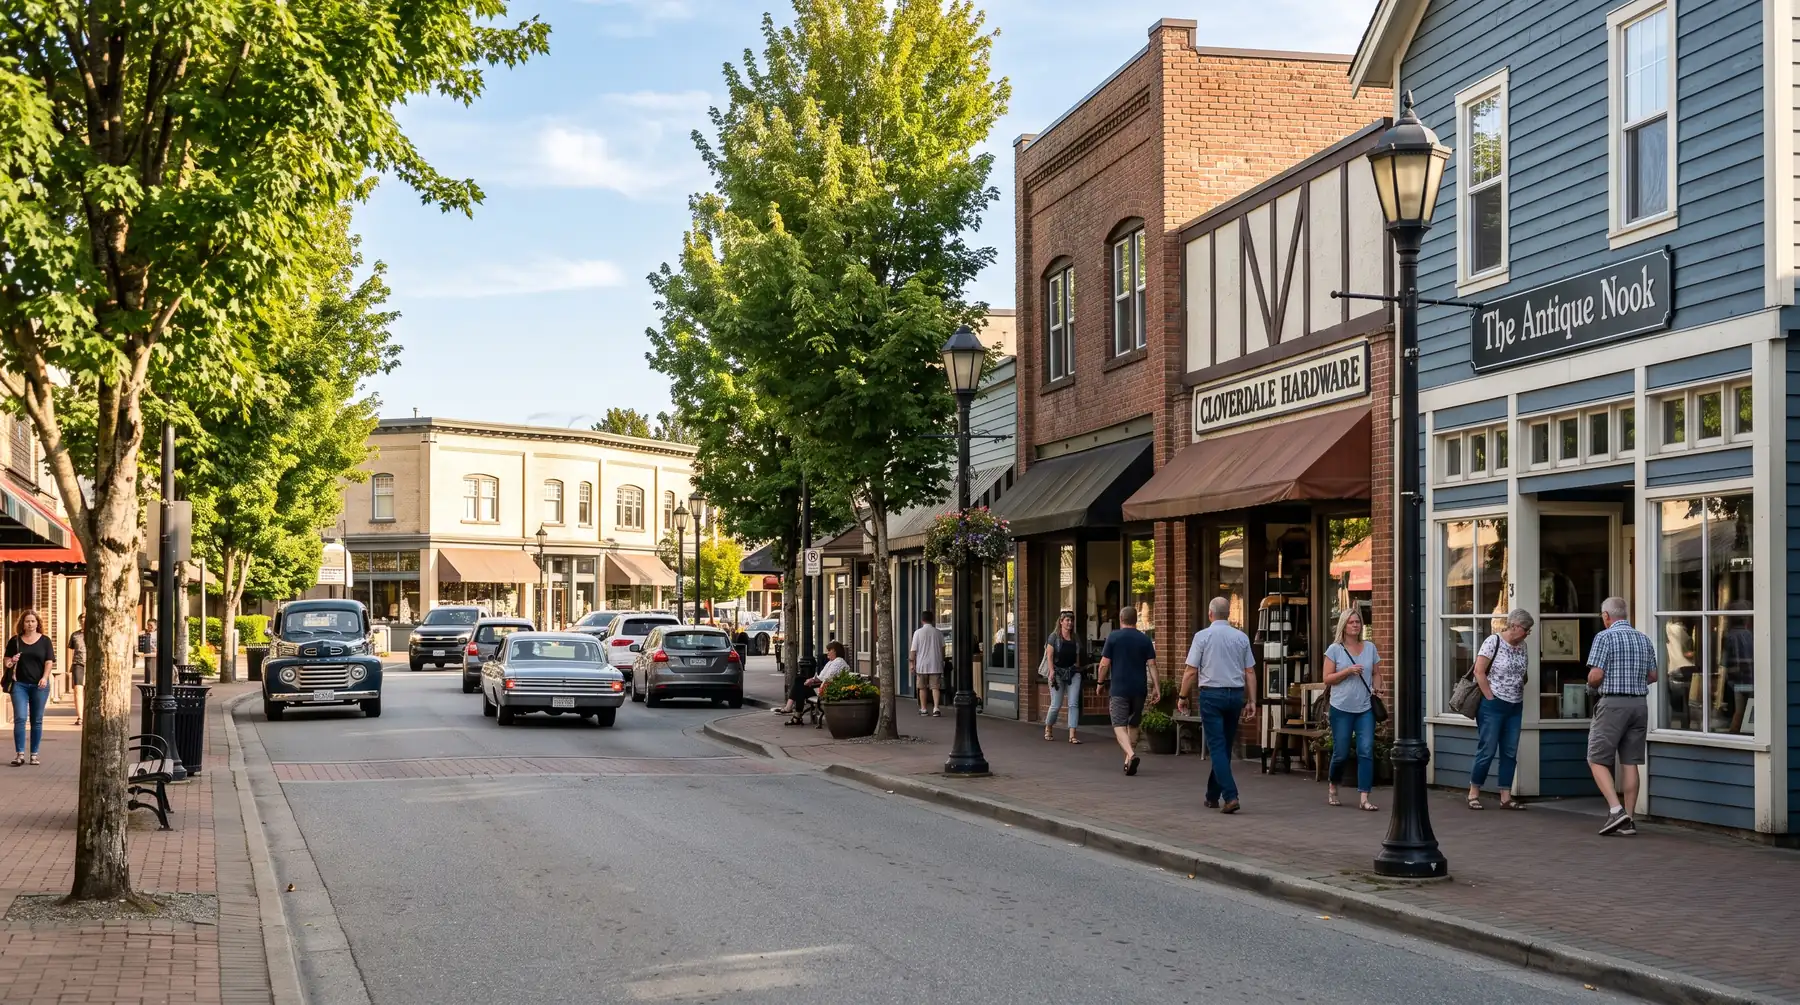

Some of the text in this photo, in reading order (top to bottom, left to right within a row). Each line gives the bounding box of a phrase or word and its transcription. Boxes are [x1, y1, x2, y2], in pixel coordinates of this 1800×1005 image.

[1482, 265, 1656, 353] The Antique Nook
[1200, 355, 1361, 425] CLOVERDALE HARDWARE
[1509, 583, 1515, 598] 3
